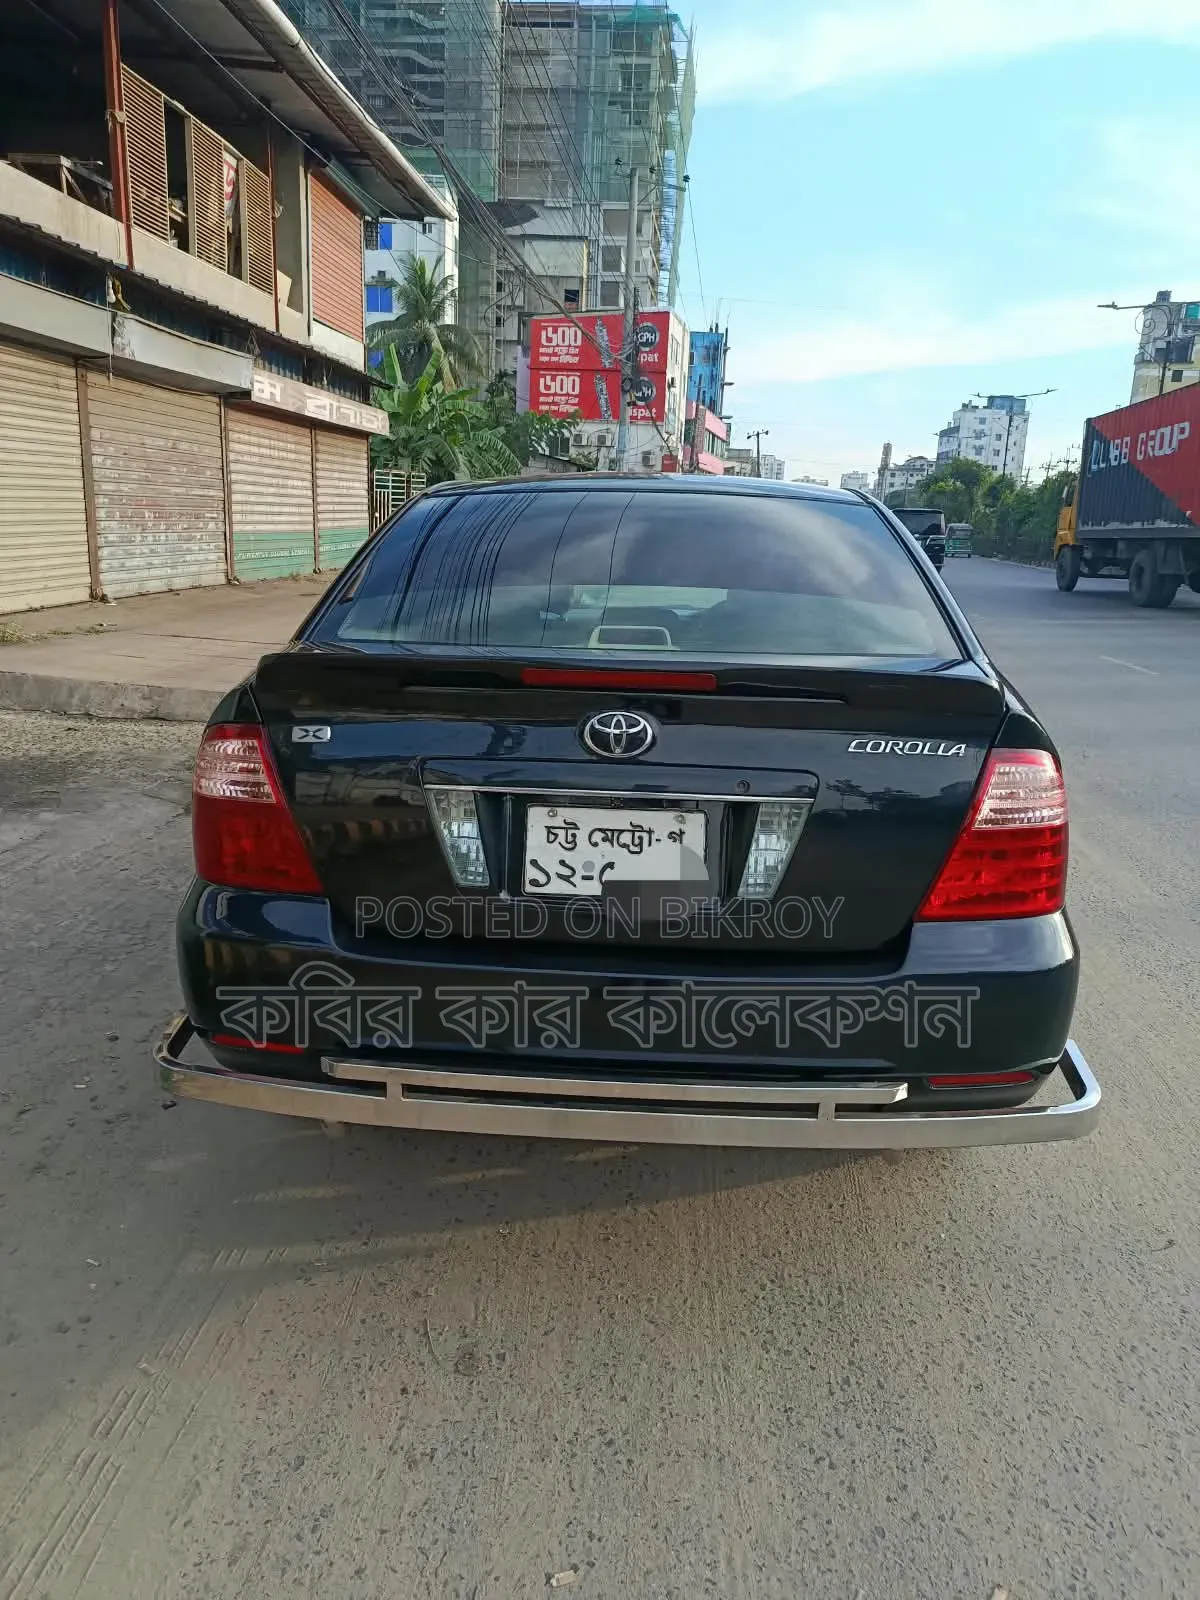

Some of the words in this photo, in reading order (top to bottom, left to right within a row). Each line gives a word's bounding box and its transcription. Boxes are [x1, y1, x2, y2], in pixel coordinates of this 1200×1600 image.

[637, 331, 655, 343] GPH
[637, 352, 659, 363] pat
[847, 739, 967, 757] COROLLA
